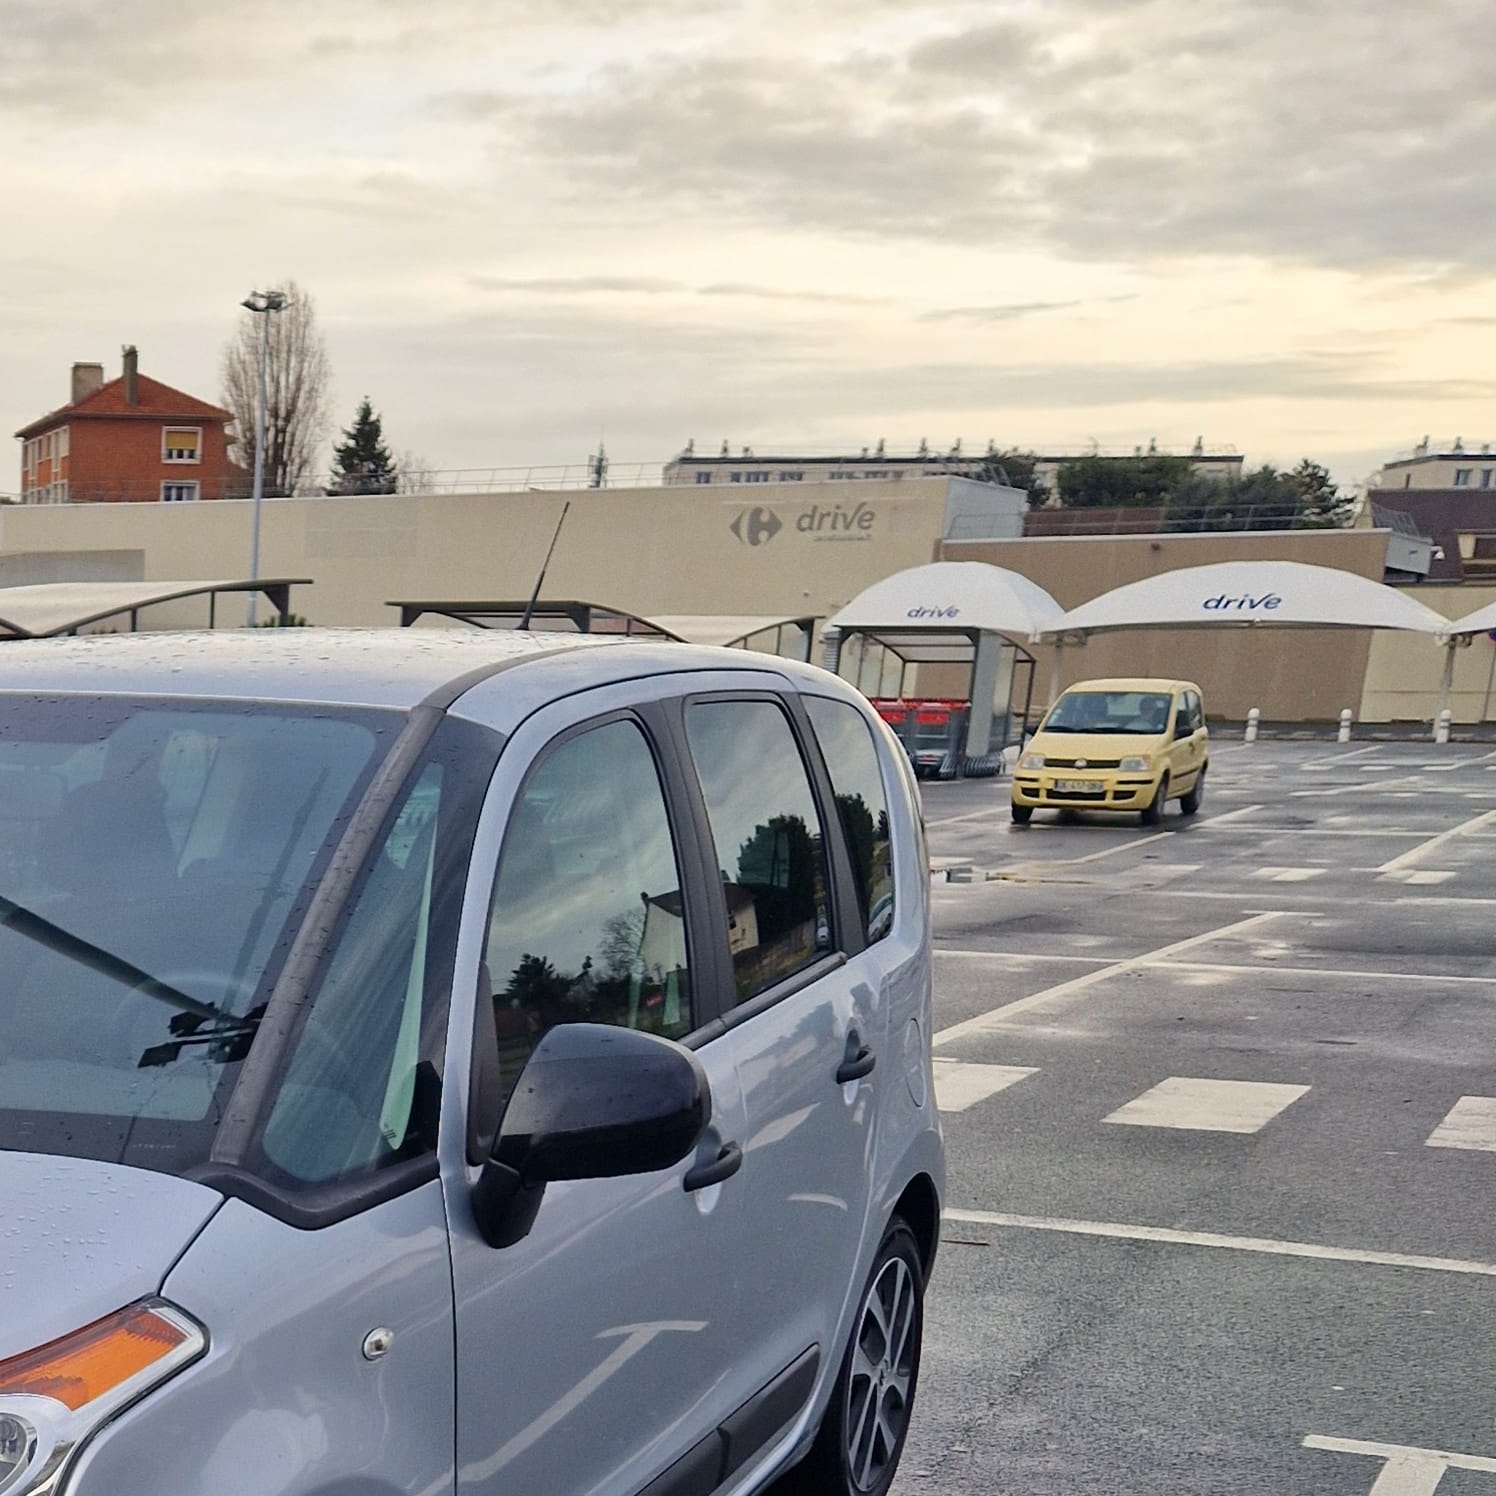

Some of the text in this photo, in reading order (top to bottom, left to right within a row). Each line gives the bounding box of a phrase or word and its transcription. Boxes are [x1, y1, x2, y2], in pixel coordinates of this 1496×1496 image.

[796, 501, 875, 532] drive
[1203, 593, 1282, 610] drive
[906, 605, 960, 618] drive
